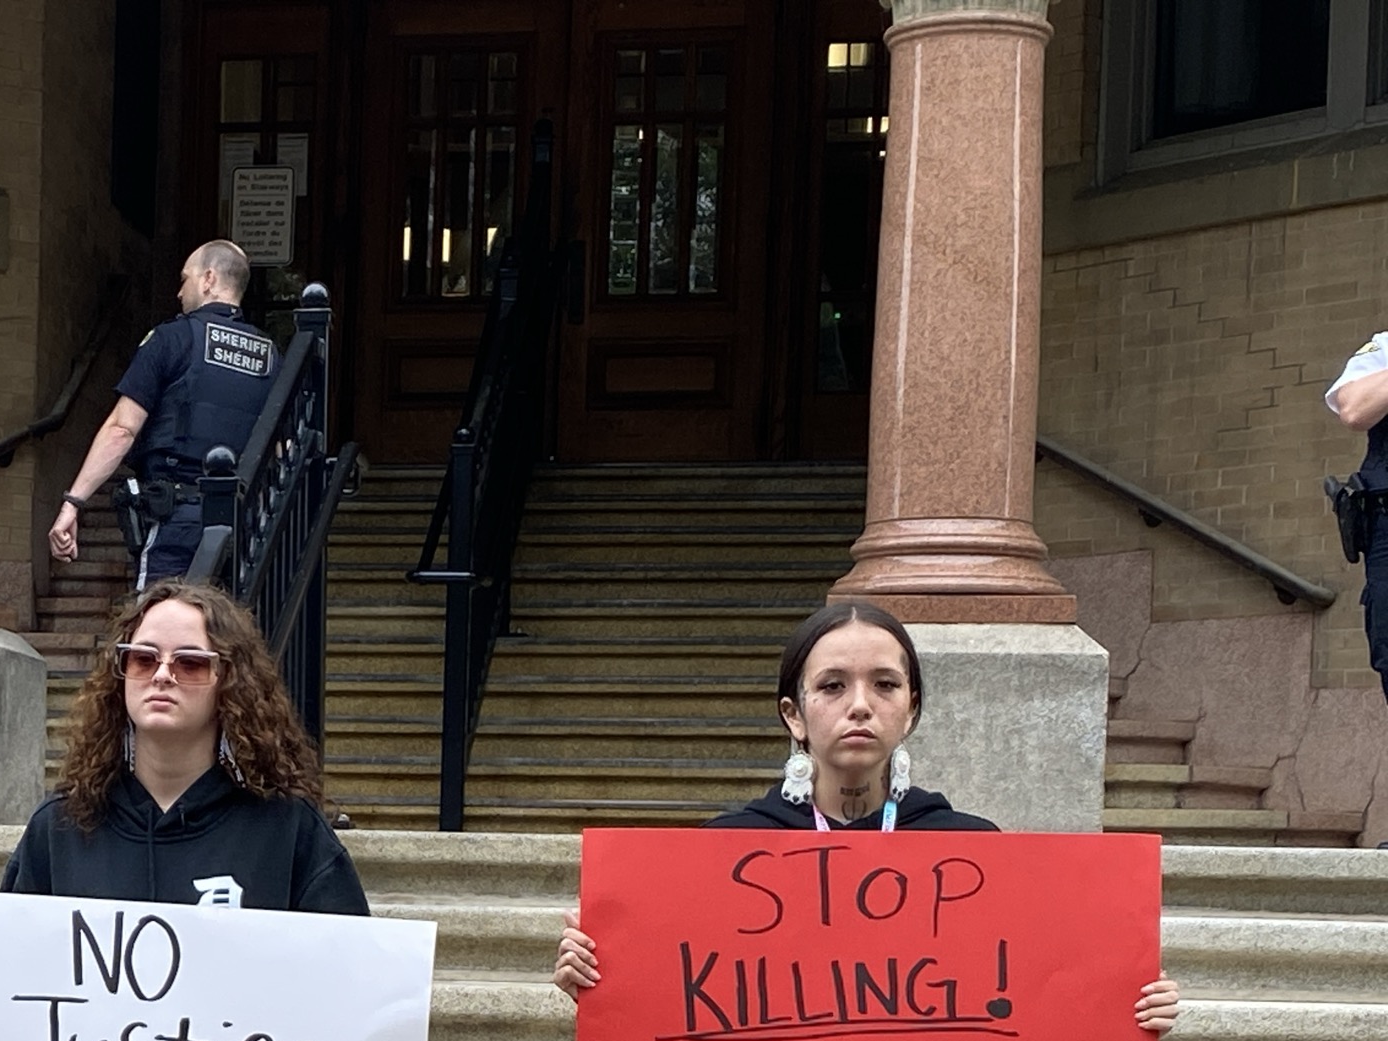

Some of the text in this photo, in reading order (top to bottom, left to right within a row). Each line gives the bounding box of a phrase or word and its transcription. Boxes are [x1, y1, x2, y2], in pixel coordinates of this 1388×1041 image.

[210, 329, 268, 356] SHERIFF
[213, 347, 264, 372] SHÉRIF
[732, 846, 985, 938] STOP
[71, 909, 181, 1002] NO
[679, 939, 1013, 1034] KILLING!
